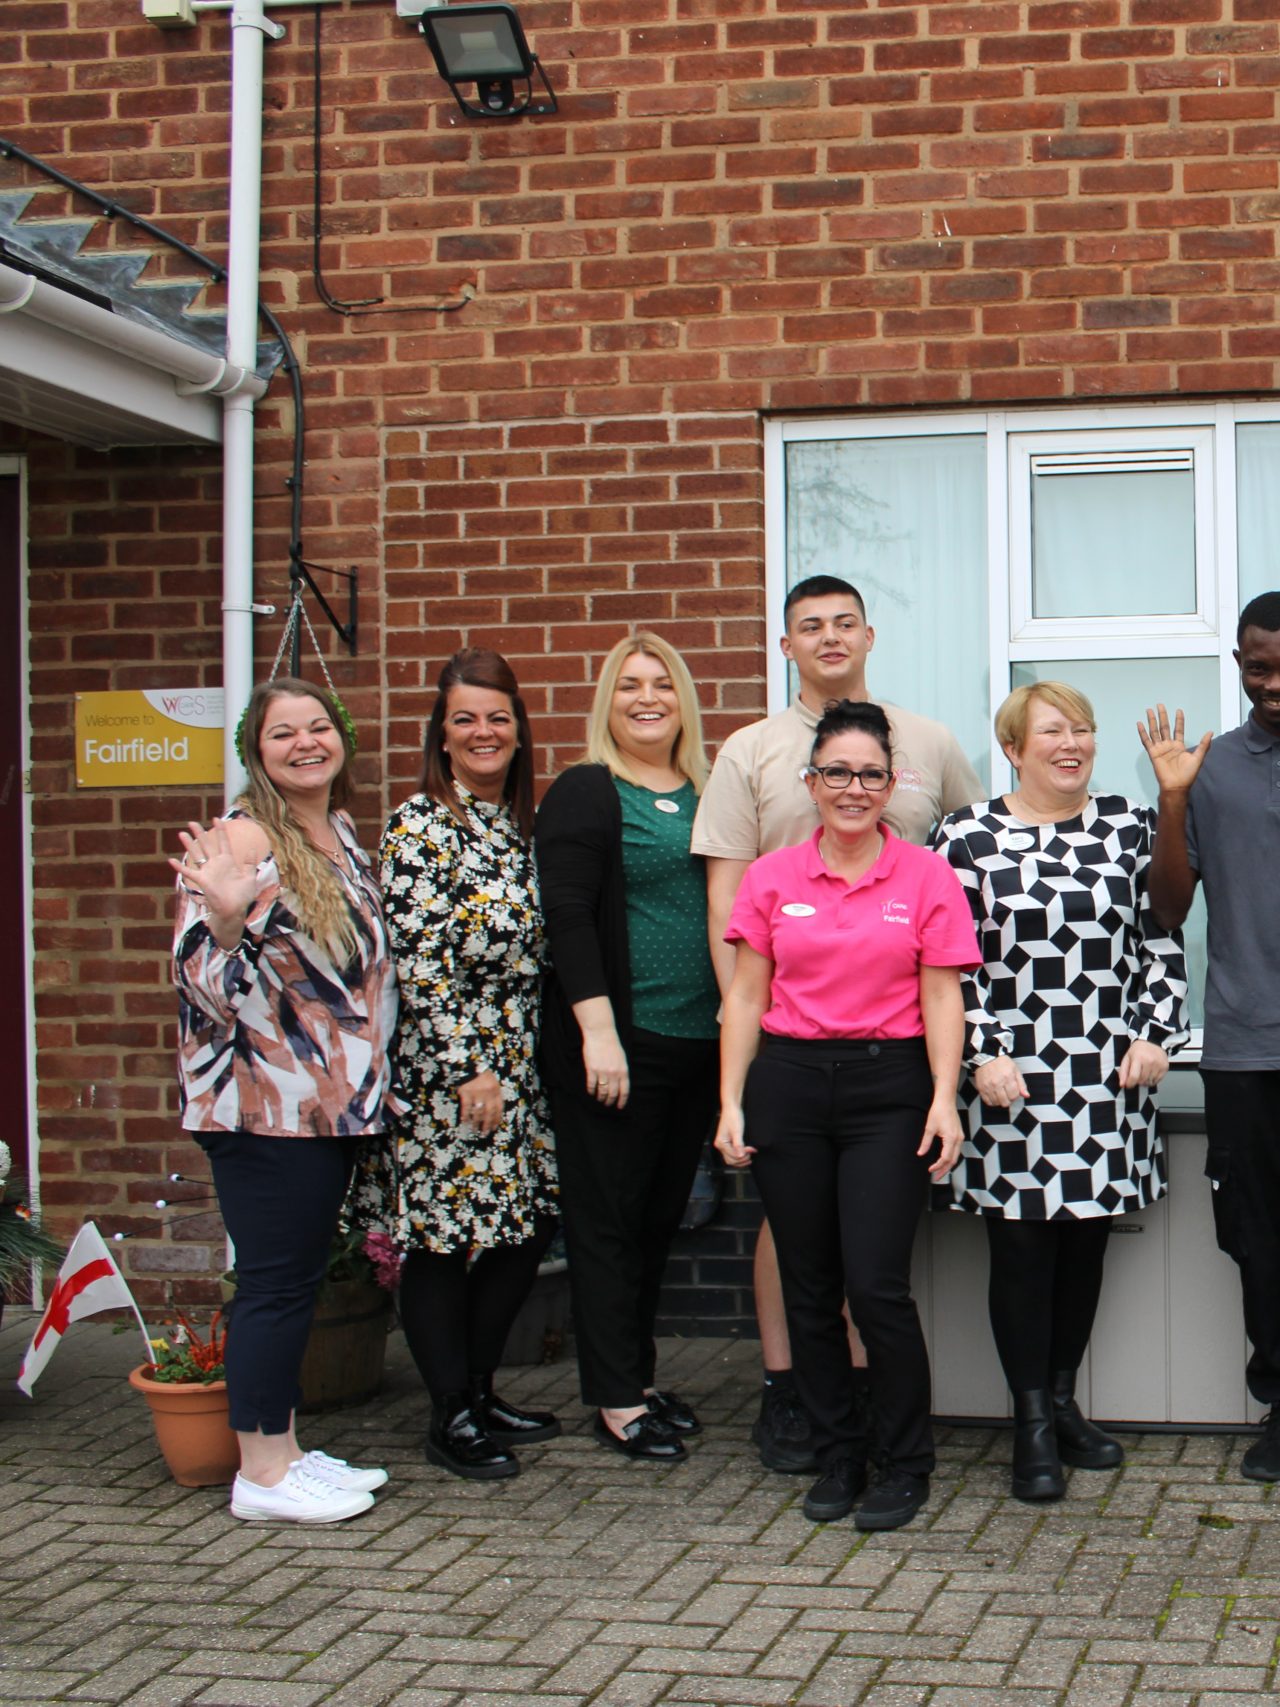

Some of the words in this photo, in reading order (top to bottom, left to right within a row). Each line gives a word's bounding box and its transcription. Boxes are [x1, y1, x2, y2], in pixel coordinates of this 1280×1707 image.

[84, 714, 140, 727] Welcome
[143, 714, 155, 726] to
[85, 736, 189, 764] Fairfield
